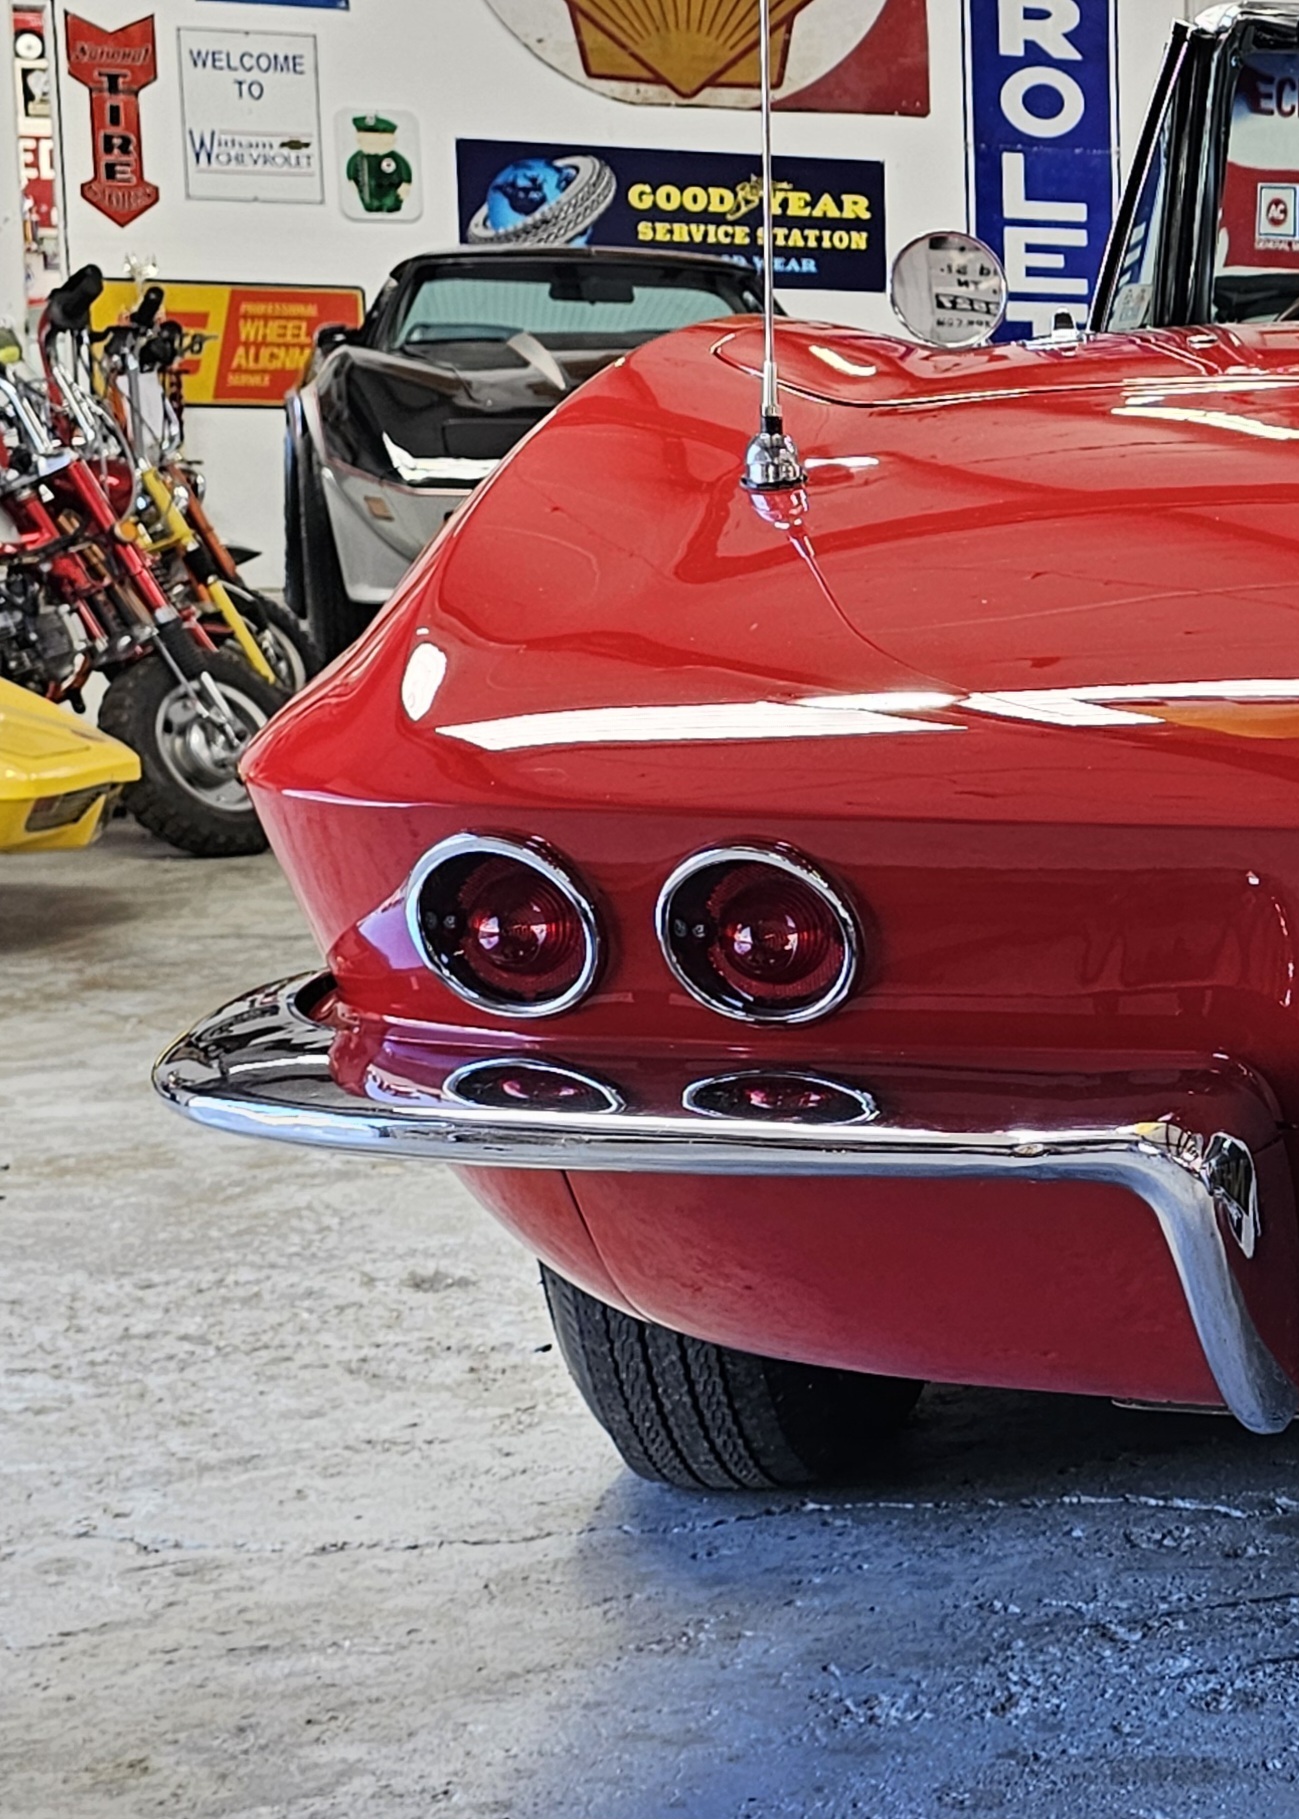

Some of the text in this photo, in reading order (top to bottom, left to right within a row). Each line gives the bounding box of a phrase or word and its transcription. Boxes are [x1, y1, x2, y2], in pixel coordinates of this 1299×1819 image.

[189, 48, 306, 75] WELCOME
[233, 79, 264, 101] TO
[96, 69, 136, 185] TIRE
[189, 127, 274, 166] Witham
[215, 151, 313, 168] CHEVROLET
[1268, 202, 1286, 221] AC
[637, 221, 750, 245] SERVICE
[239, 318, 311, 343] WHEEL
